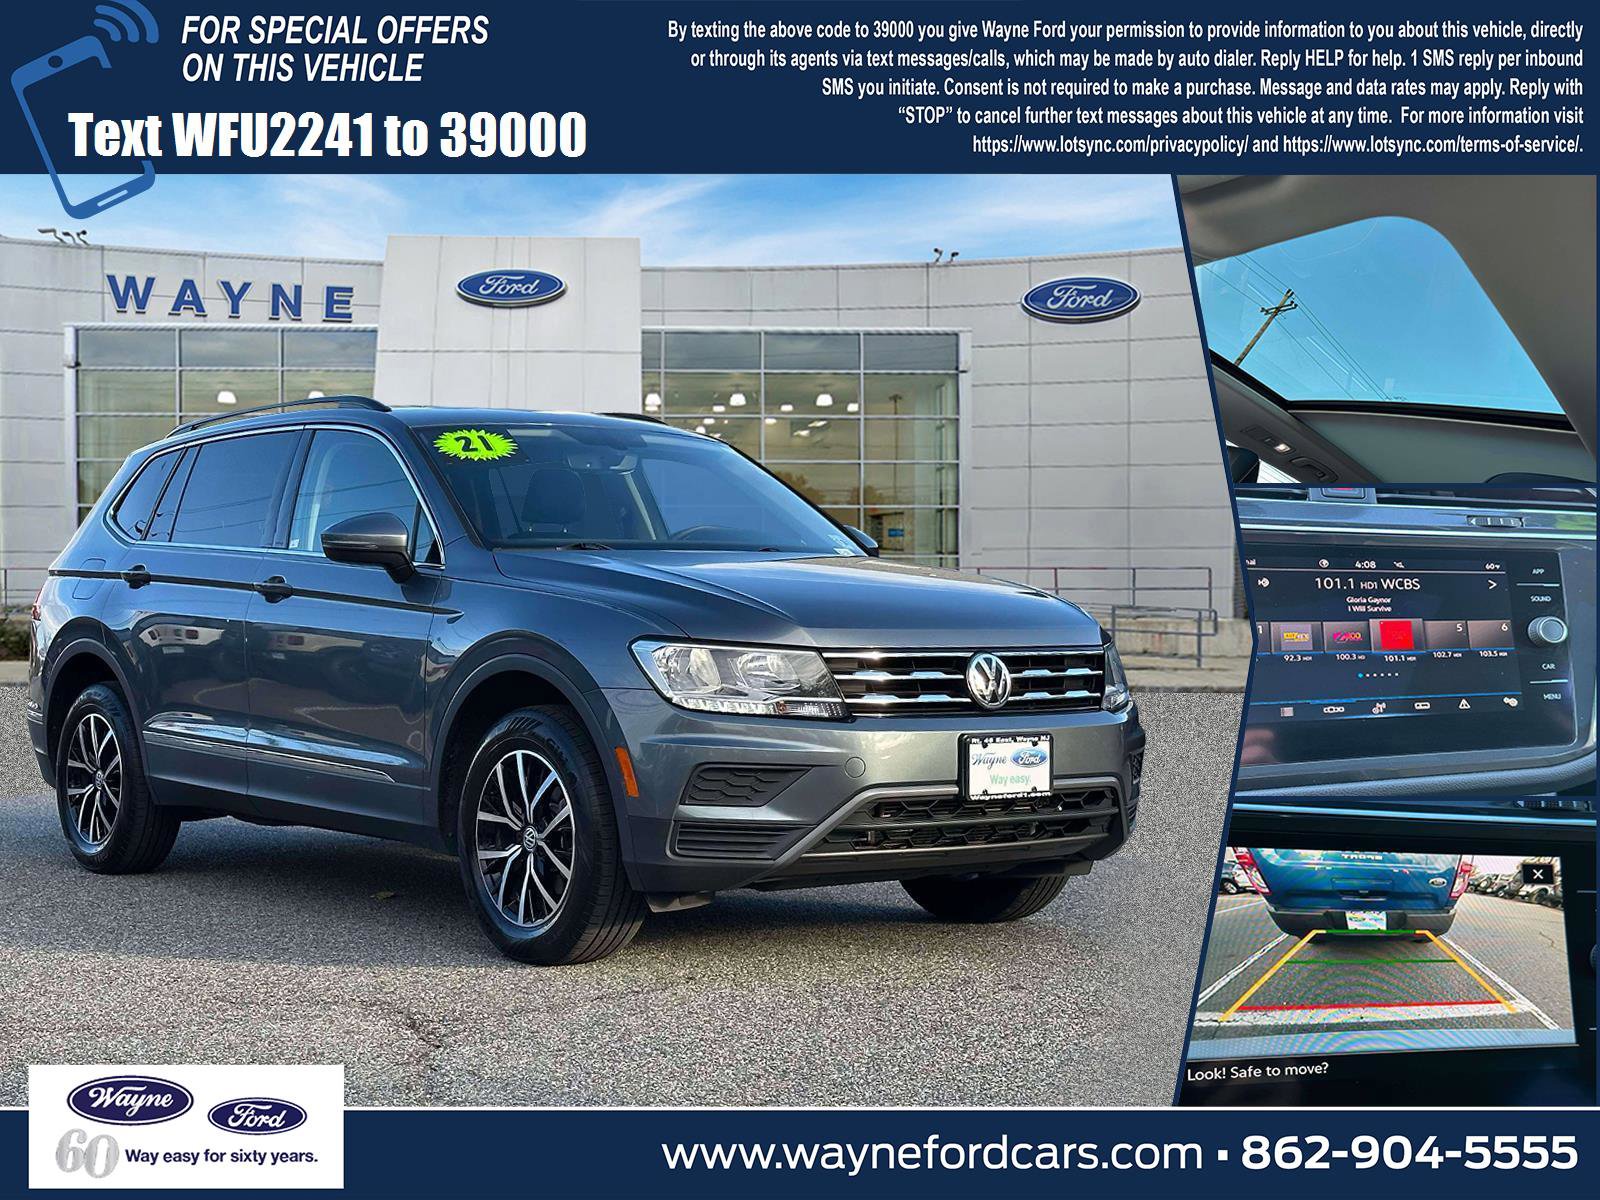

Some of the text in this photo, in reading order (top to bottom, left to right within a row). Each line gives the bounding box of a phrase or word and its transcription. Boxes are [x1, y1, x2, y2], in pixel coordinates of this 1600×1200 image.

[478, 275, 541, 295] Ford
[106, 274, 354, 321] WAYNE
[1046, 284, 1114, 309] Ford
[454, 434, 495, 453] 21
[1354, 560, 1377, 569] 4:08
[1315, 577, 1421, 591] 101.1 HD1 WCBS
[1456, 623, 1464, 632] 5
[1501, 623, 1509, 632] 6
[1283, 654, 1302, 662] 92.3
[1336, 653, 1357, 661] 100.3
[1384, 654, 1405, 663] 101.1
[1479, 650, 1499, 658] 103.5
[971, 752, 1008, 770] Wayne
[990, 774, 1008, 786] Way
[1186, 1061, 1329, 1081] Look! Safe to move?
